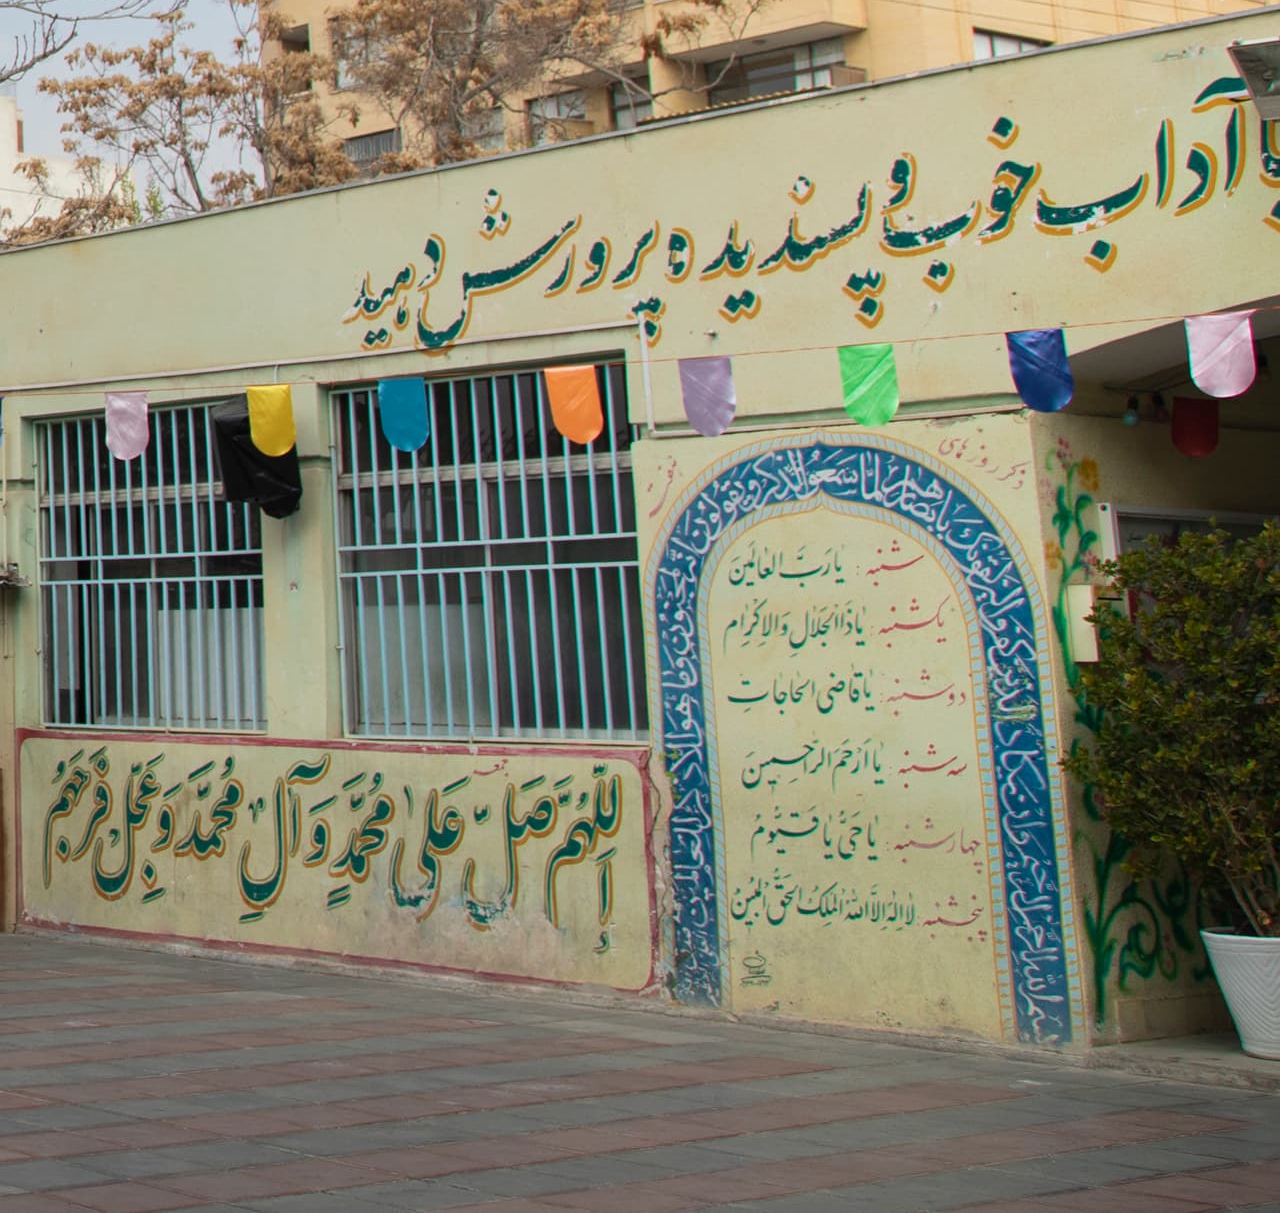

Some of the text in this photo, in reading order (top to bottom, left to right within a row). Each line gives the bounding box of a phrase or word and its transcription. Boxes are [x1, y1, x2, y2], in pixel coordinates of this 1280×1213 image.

[664, 174, 890, 328] پسندیده
[879, 151, 916, 216] و
[881, 116, 1042, 292] خوب
[1034, 76, 1252, 273] آداب
[343, 234, 445, 351] دهید
[415, 188, 667, 357] پرورش
